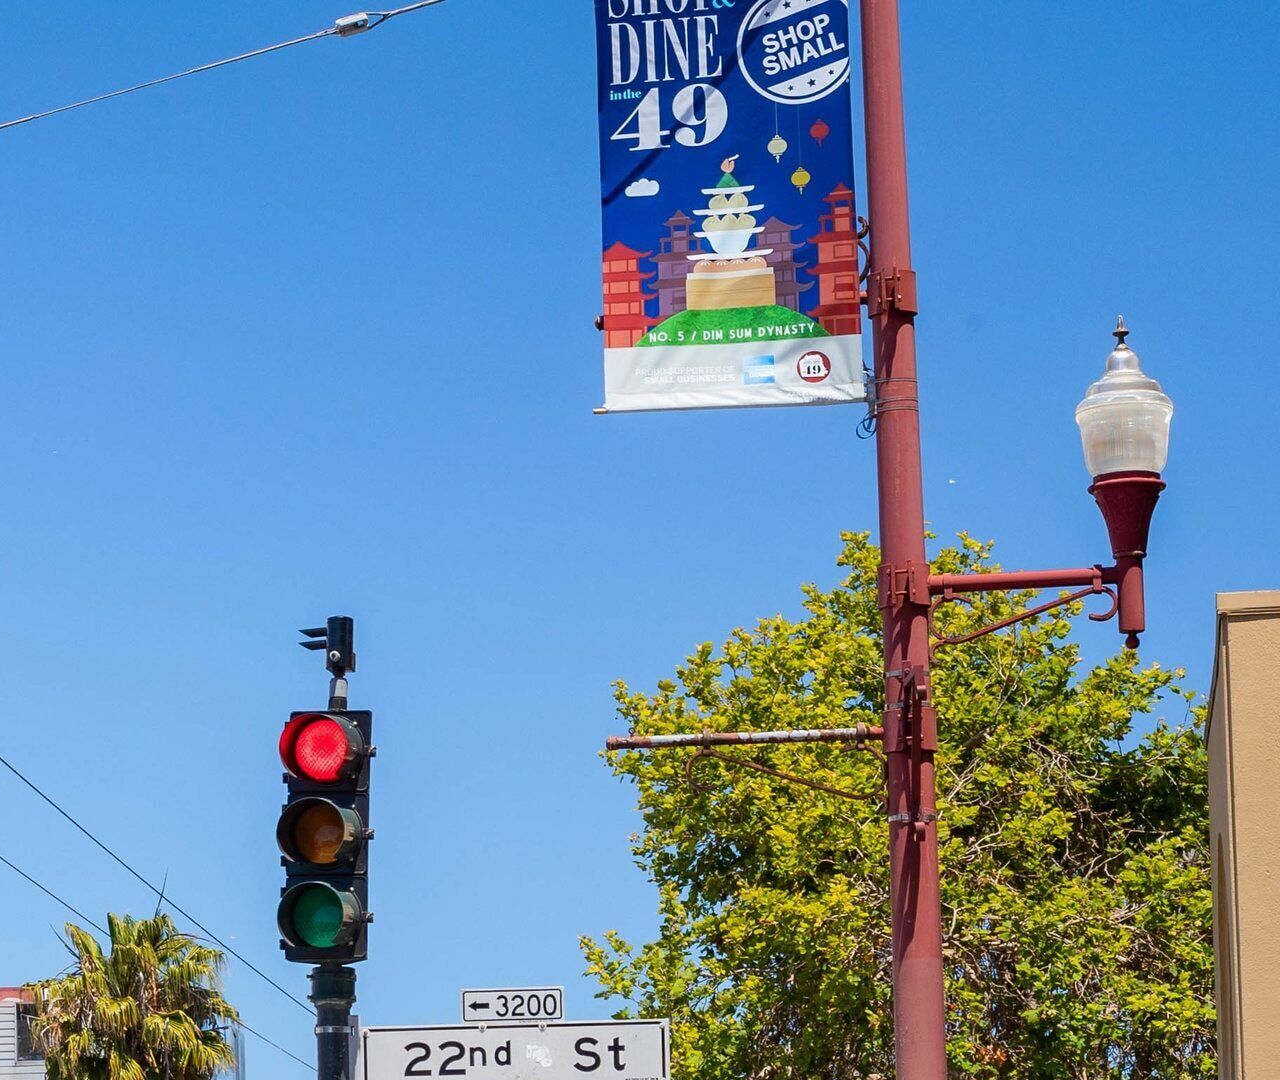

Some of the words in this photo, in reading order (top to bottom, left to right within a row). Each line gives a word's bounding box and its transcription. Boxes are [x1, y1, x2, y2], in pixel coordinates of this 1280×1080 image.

[607, 15, 723, 86] DINE
[762, 13, 830, 53] SHOP
[762, 32, 845, 76] SMALL
[610, 90, 622, 100] in
[623, 89, 642, 99] the
[610, 83, 728, 151] 49
[649, 332, 671, 343] NO.
[677, 331, 685, 340] 5
[703, 330, 723, 340] DIM
[729, 328, 752, 339] SUM
[758, 323, 815, 336] DYNASTY
[495, 993, 558, 1018] 3200
[403, 1039, 513, 1077] 22nd
[573, 1036, 627, 1073] St
